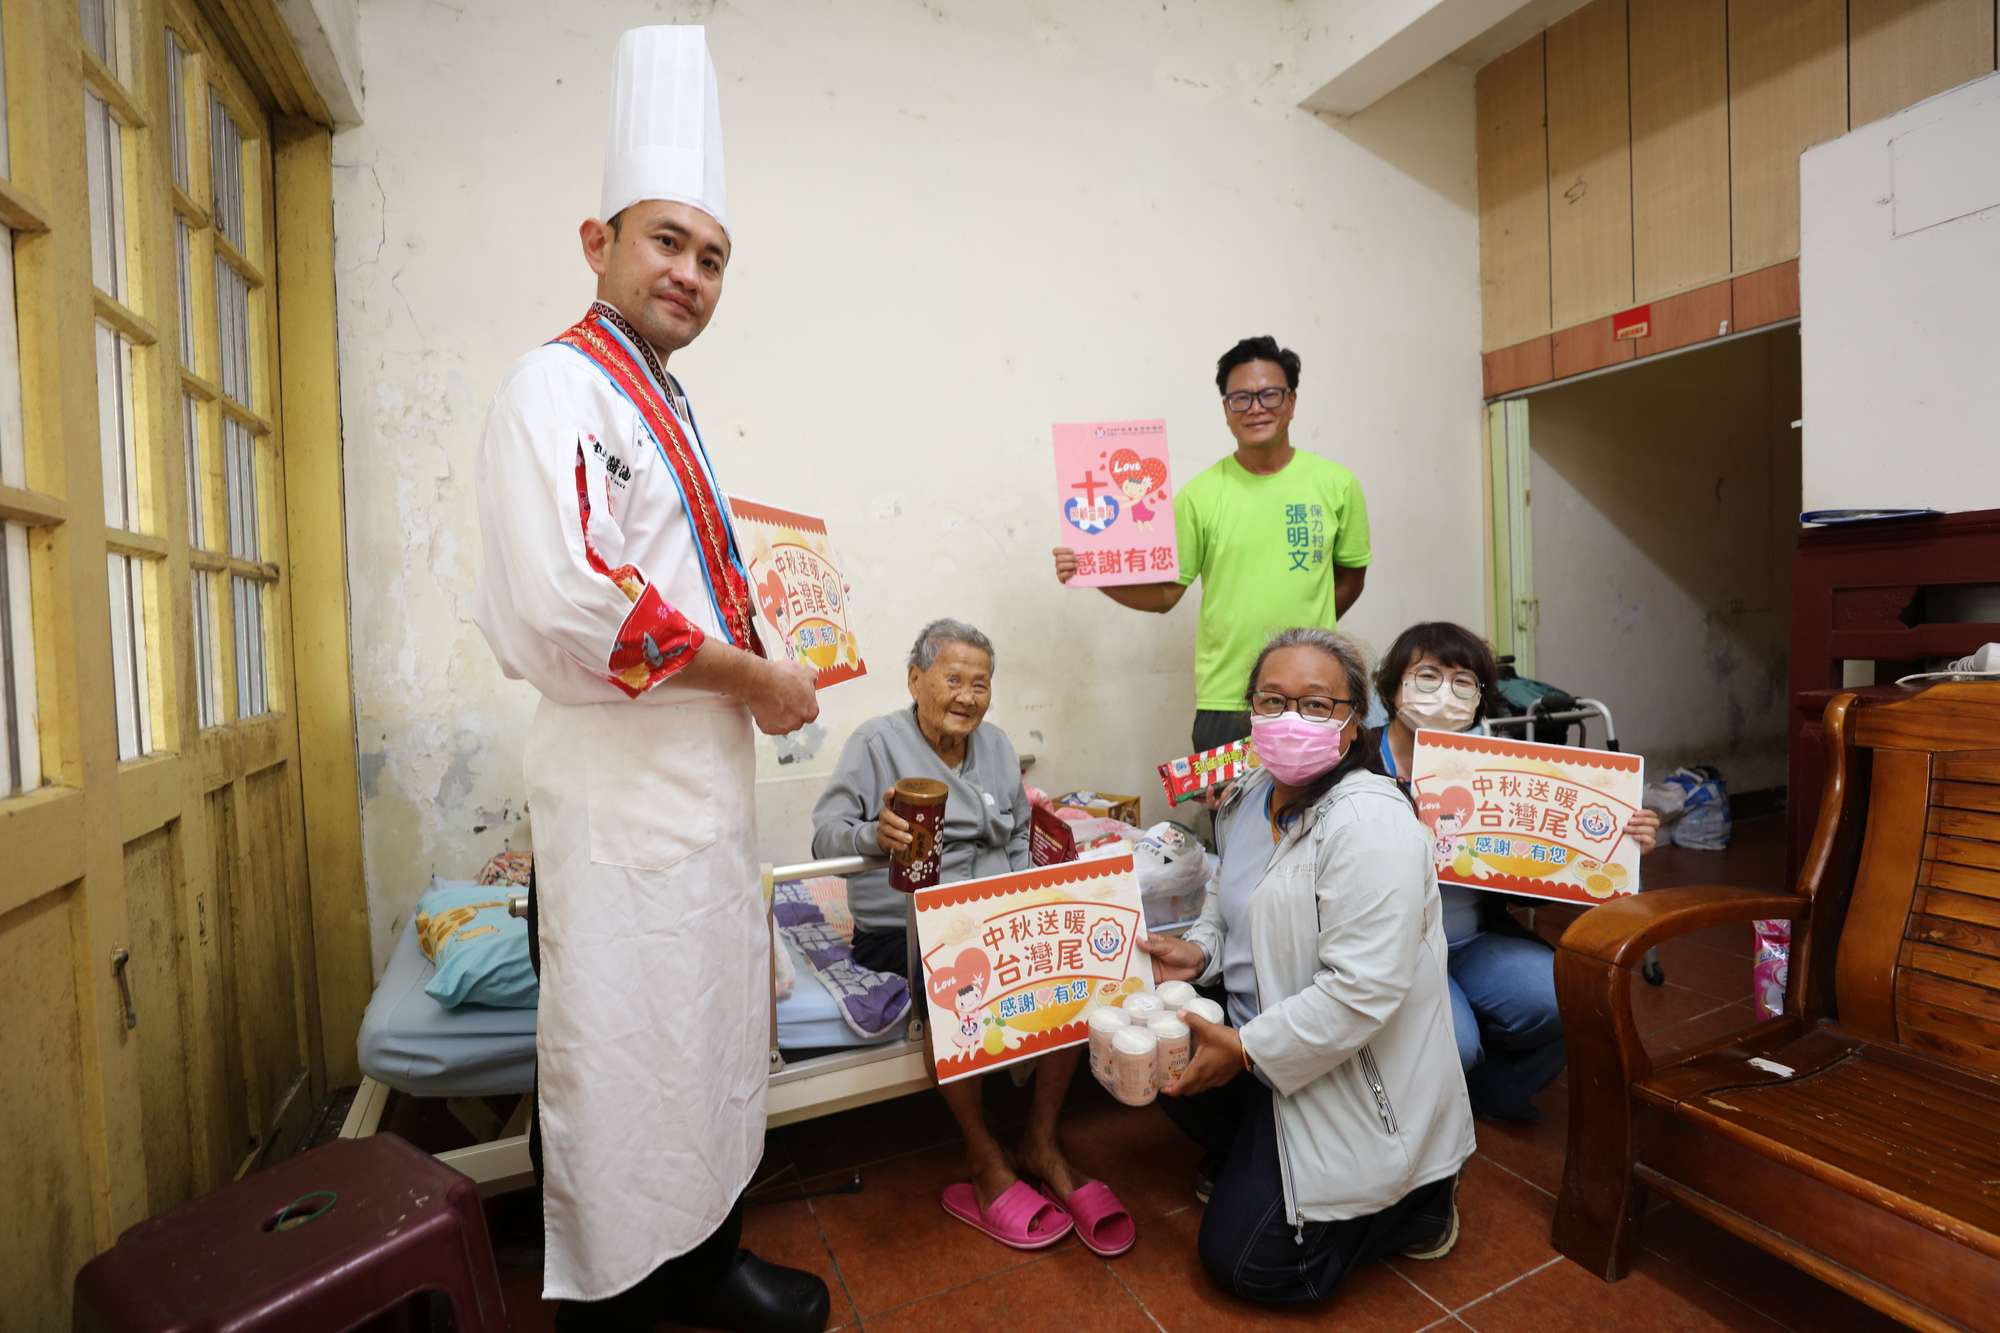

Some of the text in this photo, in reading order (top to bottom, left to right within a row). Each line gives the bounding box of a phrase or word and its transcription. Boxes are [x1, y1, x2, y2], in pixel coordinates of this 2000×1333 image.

[1114, 460, 1141, 473] Love
[1285, 504, 1310, 572] 張明文
[1075, 546, 1174, 576] 感謝有您
[787, 581, 828, 616] 台灣尾
[1472, 775, 1579, 811] 中秋送暖
[1477, 800, 1570, 839] 台灣尾
[982, 909, 1087, 952] 中秋送暖
[993, 939, 1084, 987] 台灣尾
